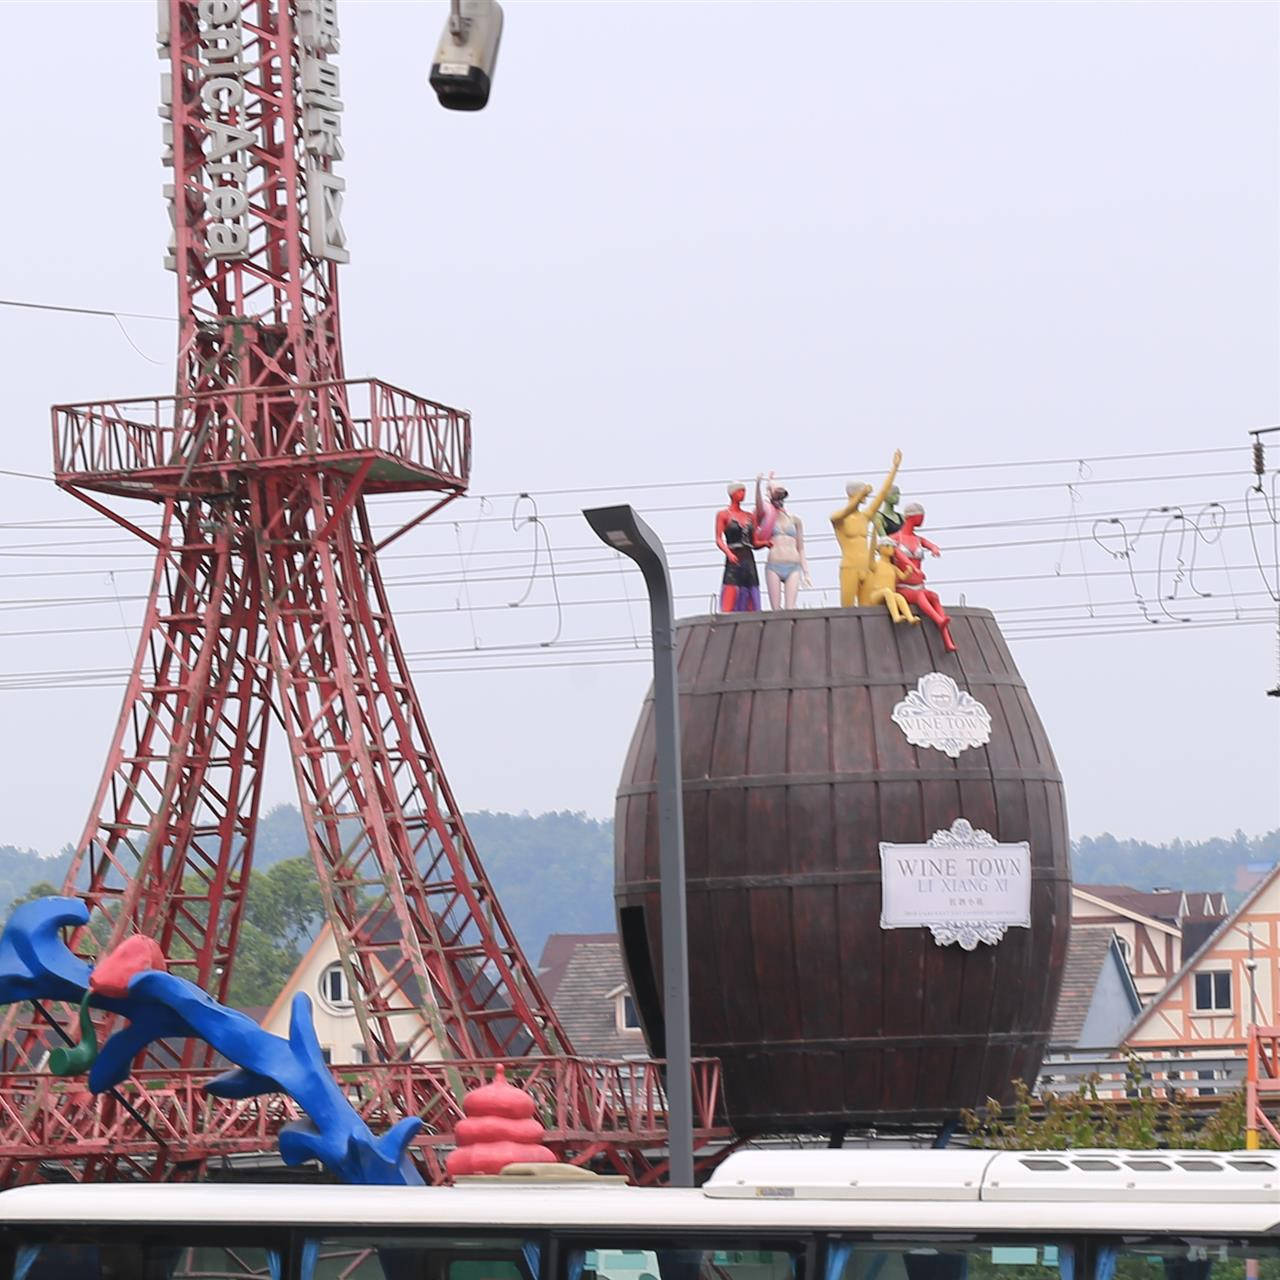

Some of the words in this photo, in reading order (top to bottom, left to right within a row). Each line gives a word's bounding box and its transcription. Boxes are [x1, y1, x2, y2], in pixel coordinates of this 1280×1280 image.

[897, 857, 957, 877] WINE
[967, 857, 1022, 877] TOWN
[917, 878, 933, 893] LI
[941, 877, 989, 893] XIANG
[994, 877, 1010, 892] XI
